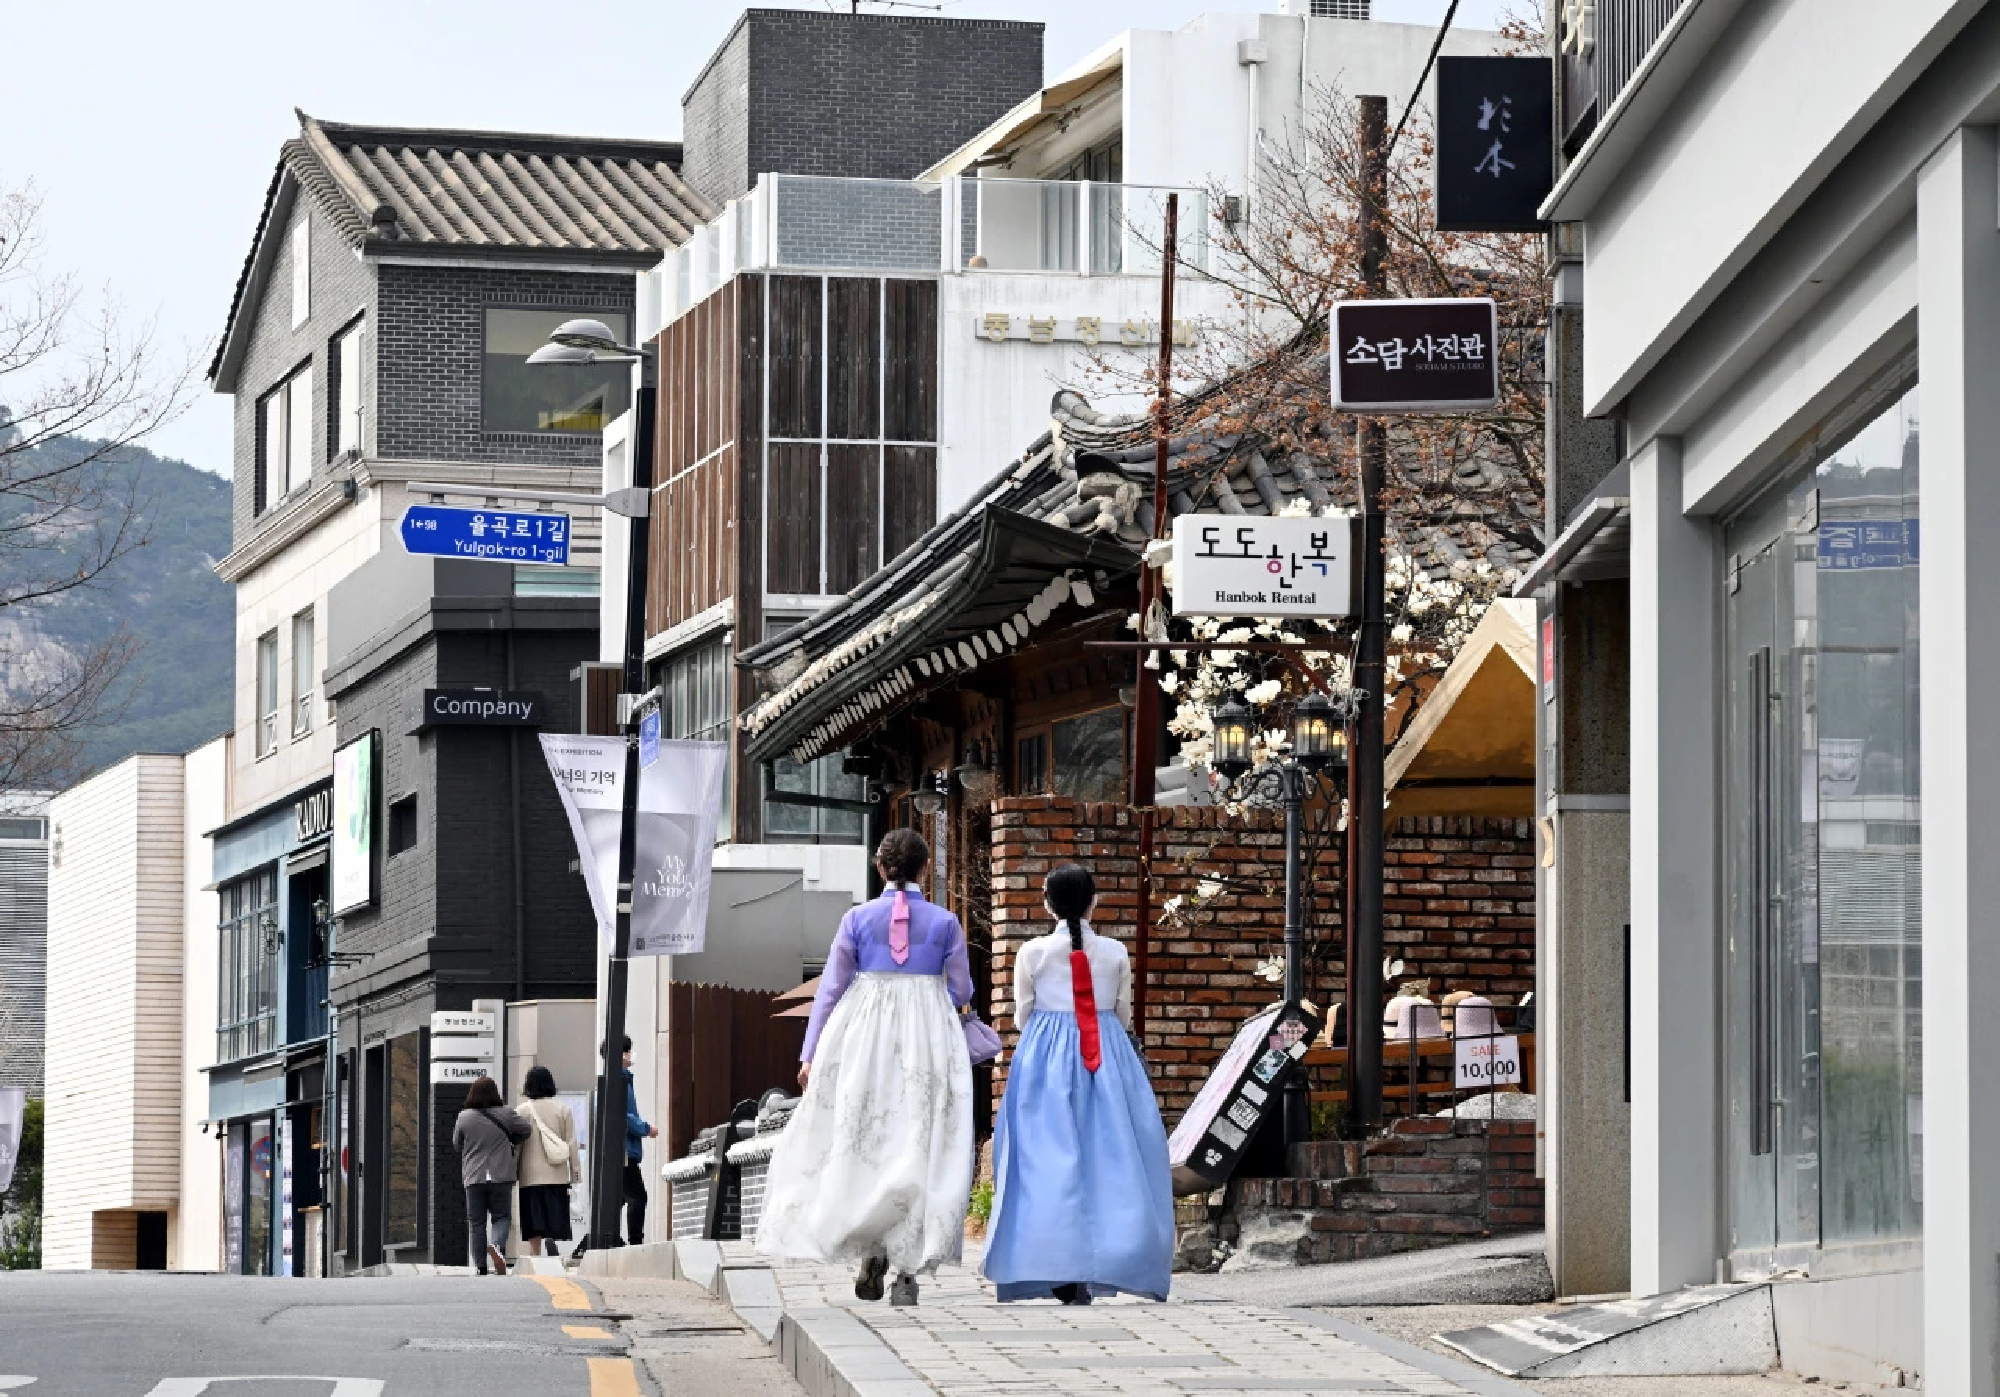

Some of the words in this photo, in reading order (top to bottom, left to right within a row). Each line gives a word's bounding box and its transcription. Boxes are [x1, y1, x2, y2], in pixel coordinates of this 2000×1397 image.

[1346, 336, 1408, 371] 소담
[1409, 333, 1486, 362] 사진관
[1450, 363, 1485, 371] STUDIO
[468, 514, 566, 543] 율곡로1길
[454, 538, 526, 557] Yulgok-ro
[532, 544, 564, 562] 1-gil
[1215, 590, 1267, 603] Hanbok
[1271, 591, 1317, 604] Rental
[433, 695, 534, 720] Company
[591, 769, 616, 786] 기억
[1470, 1044, 1501, 1057] SALE
[1460, 1059, 1516, 1079] 10,000
